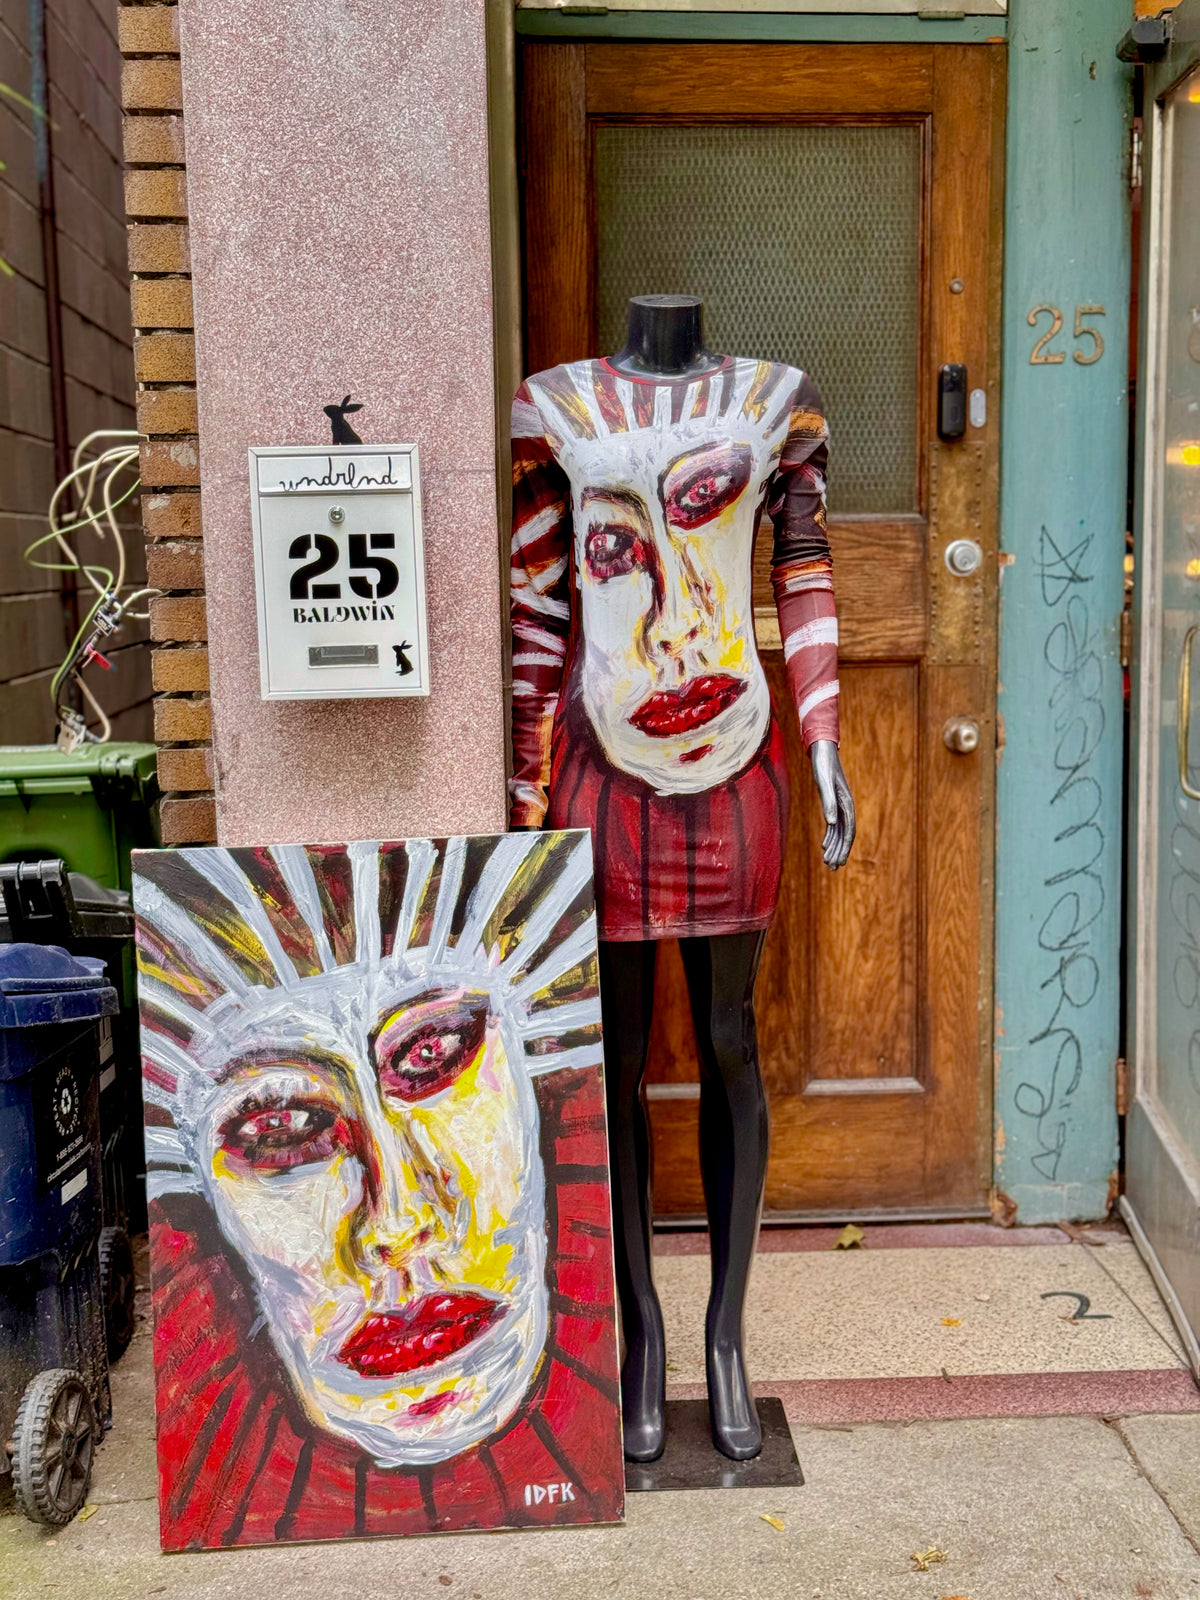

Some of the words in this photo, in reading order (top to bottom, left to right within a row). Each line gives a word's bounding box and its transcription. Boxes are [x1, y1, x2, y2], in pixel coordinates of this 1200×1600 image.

[1027, 304, 1106, 365] 25
[288, 533, 399, 600] 25
[524, 1482, 576, 1507] IDFK
